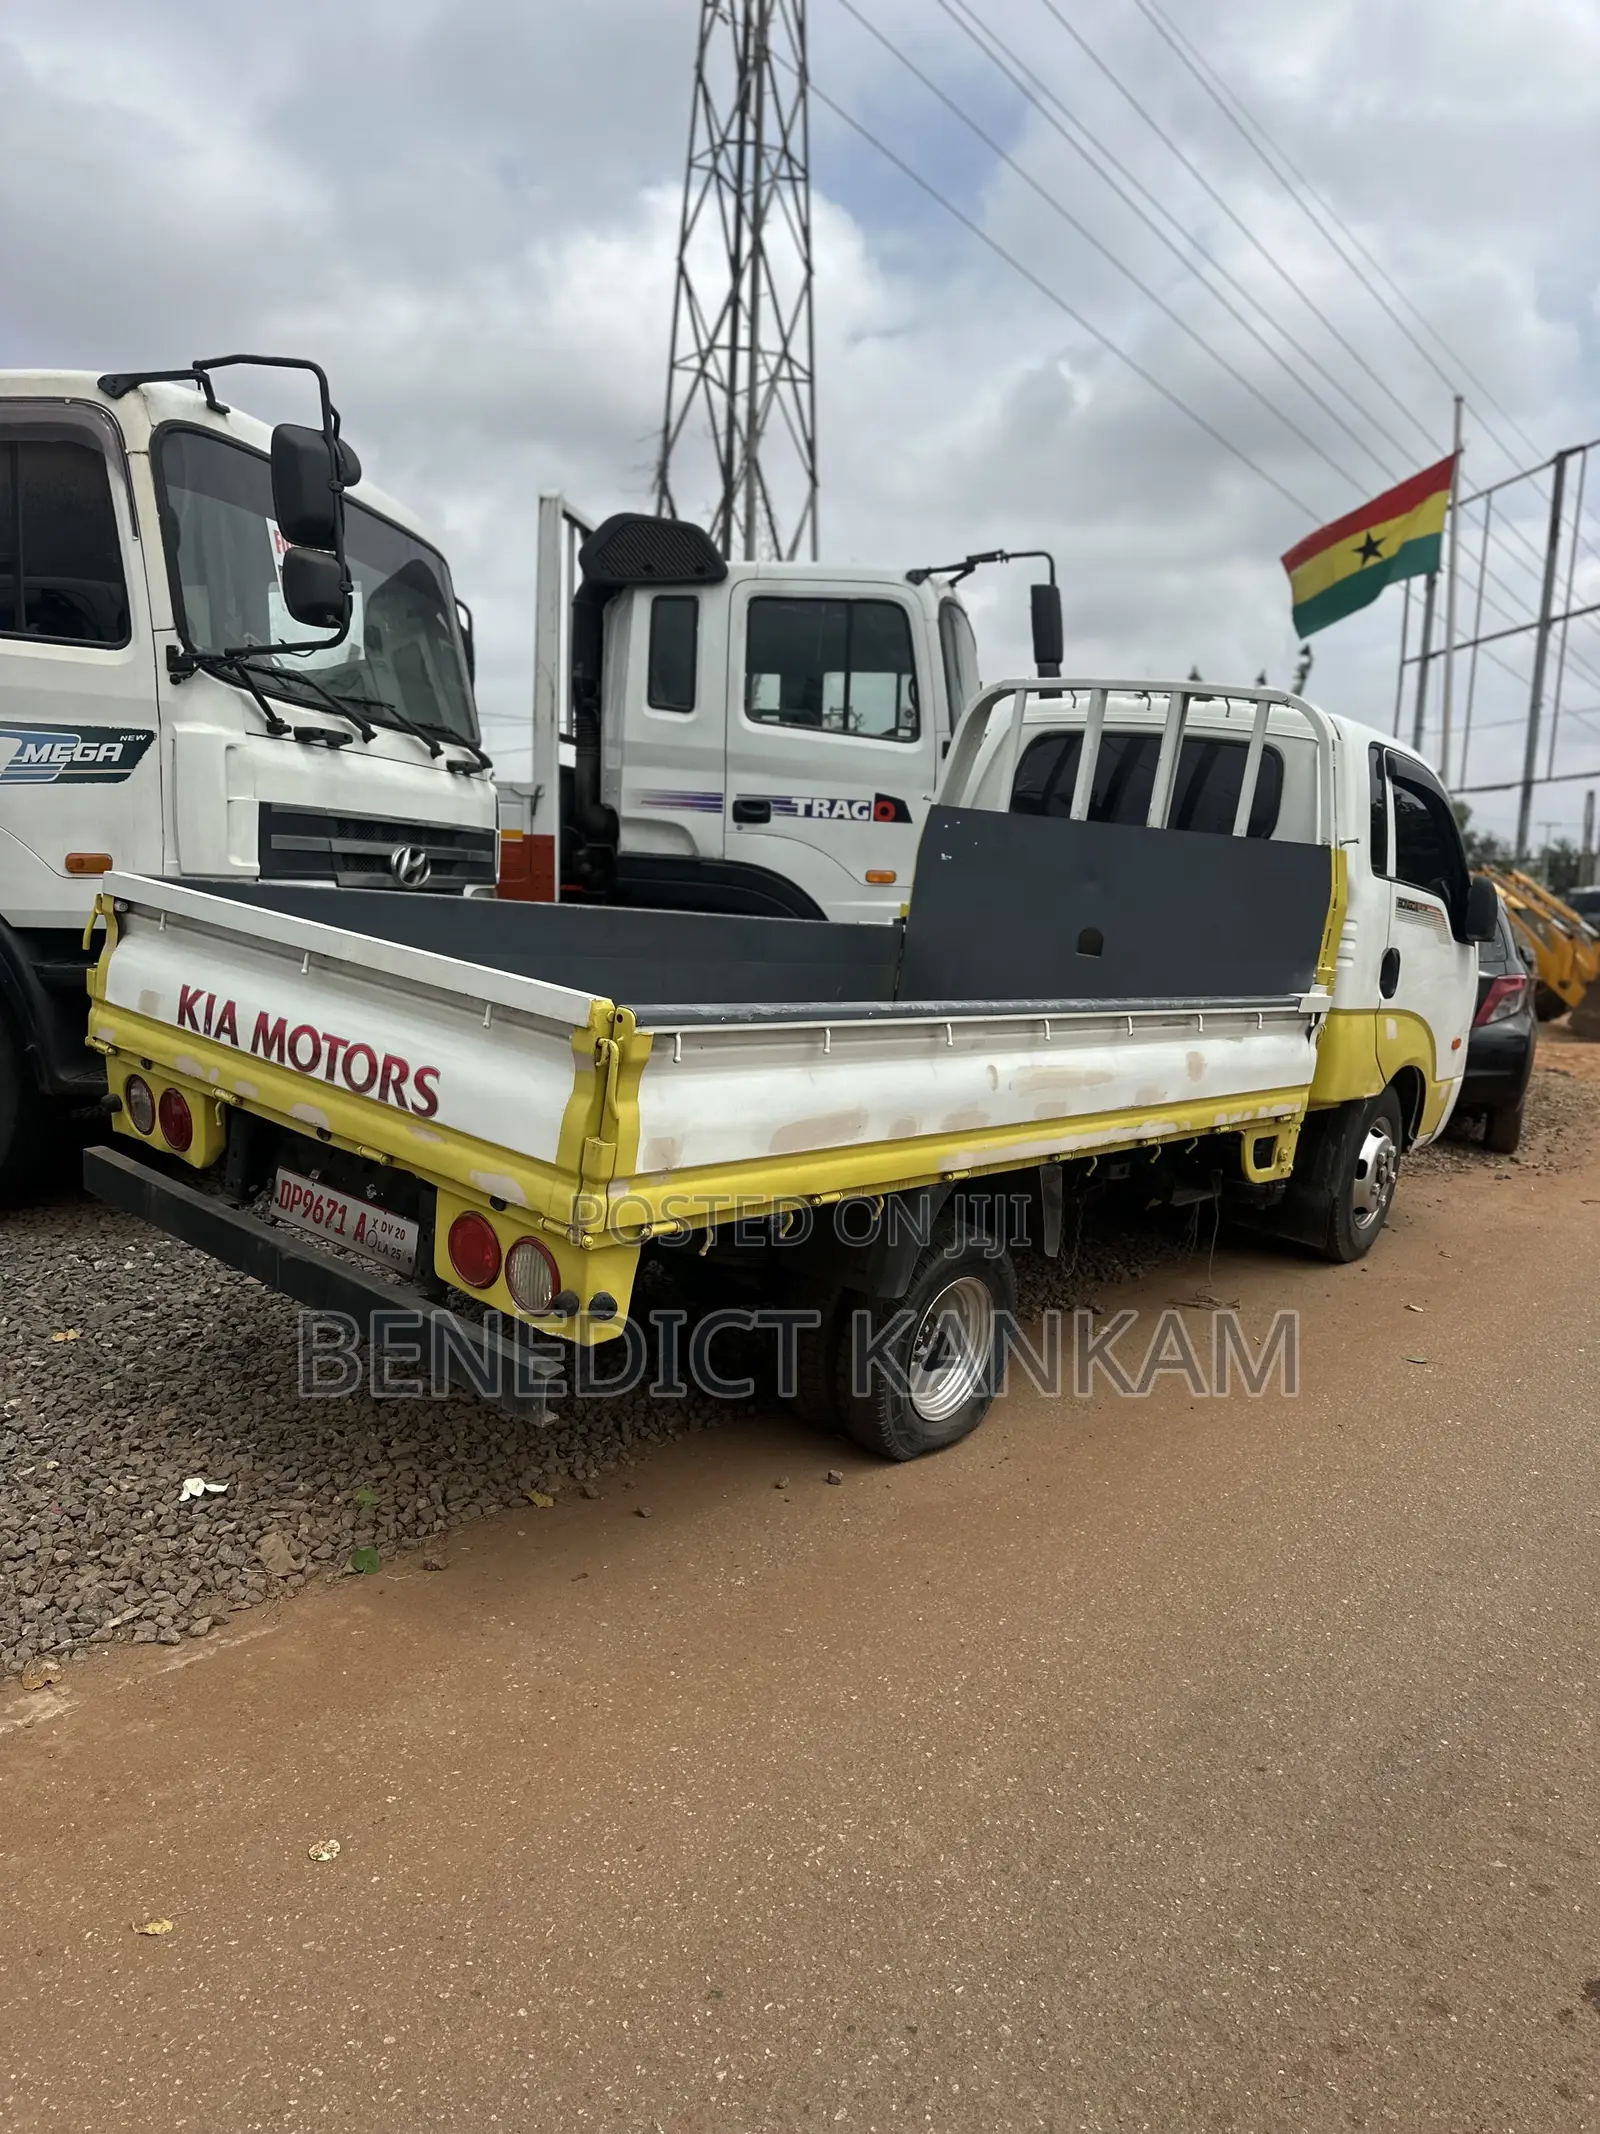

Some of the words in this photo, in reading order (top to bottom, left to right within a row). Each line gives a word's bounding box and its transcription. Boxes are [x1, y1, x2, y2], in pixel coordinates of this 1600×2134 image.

[119, 734, 147, 742] NEW
[21, 742, 124, 763] MEGA
[791, 797, 896, 822] TRAGO
[177, 984, 240, 1047] KIA
[250, 1010, 441, 1119] MOTORS
[278, 1179, 348, 1236] DP9671
[353, 1211, 367, 1244] A
[381, 1221, 393, 1235] DV
[395, 1227, 406, 1241] 20
[390, 1246, 402, 1260] 25
